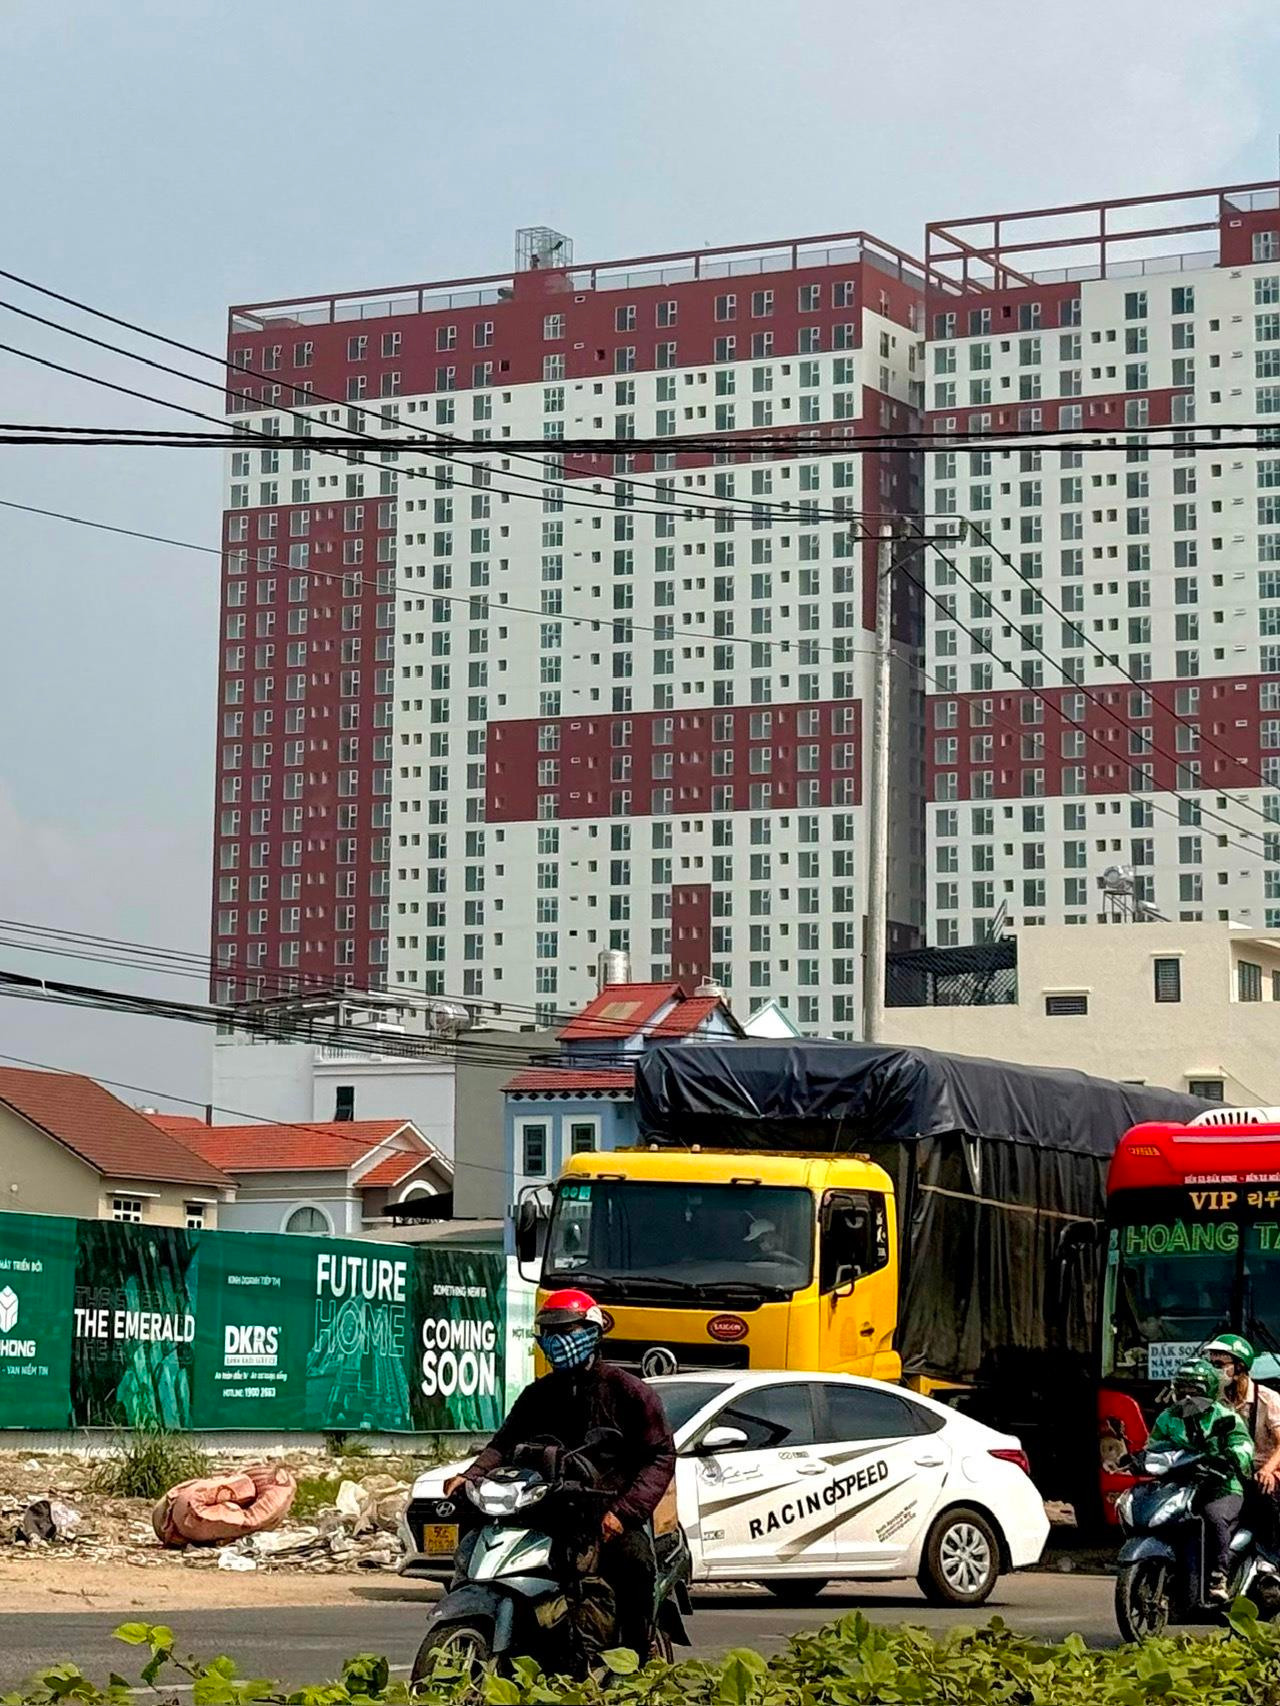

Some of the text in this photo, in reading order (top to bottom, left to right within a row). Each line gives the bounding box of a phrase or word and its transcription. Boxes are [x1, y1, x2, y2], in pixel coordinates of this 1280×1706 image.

[1189, 1192, 1238, 1210] VIP
[1126, 1218, 1280, 1252] HOÀNG T
[317, 1253, 407, 1302] FUTURE
[74, 1308, 195, 1342] THE EMERALD
[314, 1298, 406, 1356] HOME
[422, 1318, 496, 1351] COMING
[421, 1350, 496, 1396] SOON
